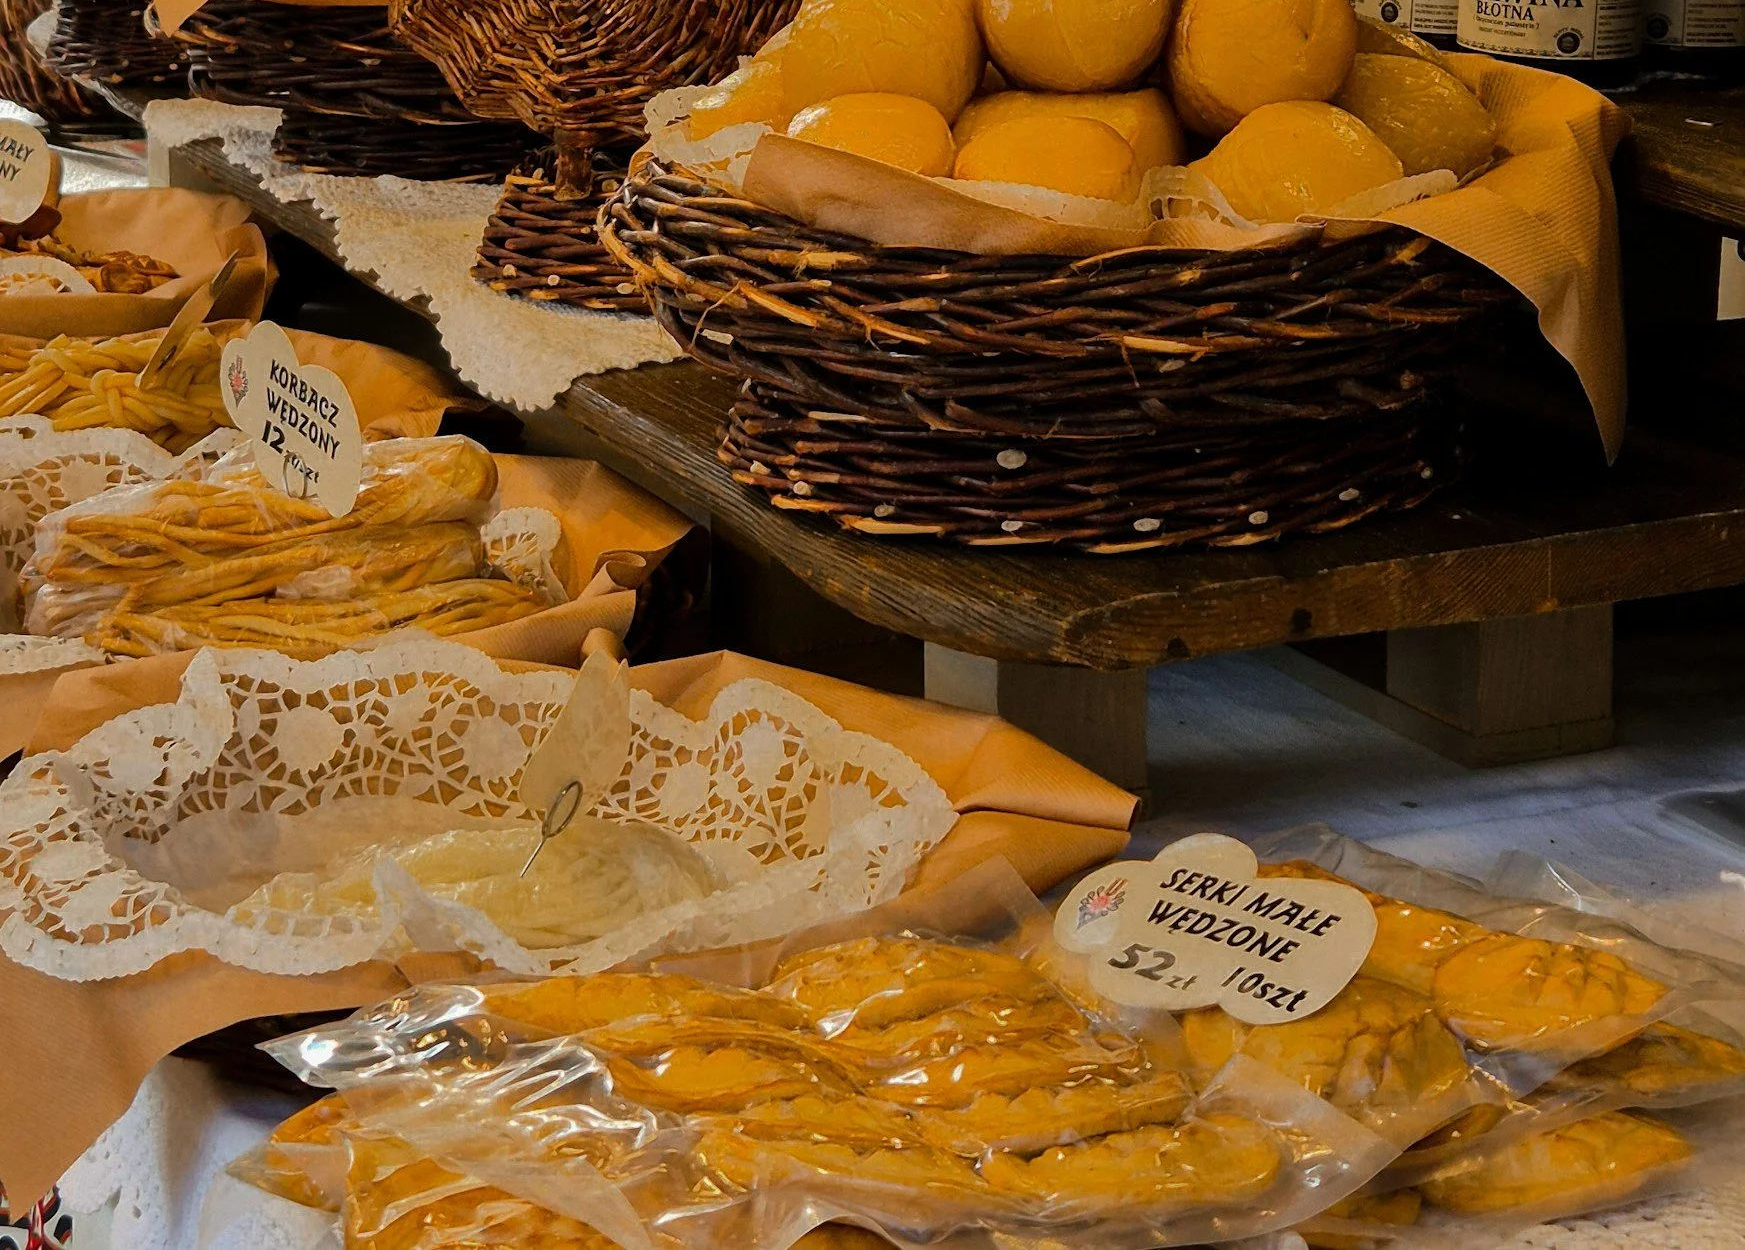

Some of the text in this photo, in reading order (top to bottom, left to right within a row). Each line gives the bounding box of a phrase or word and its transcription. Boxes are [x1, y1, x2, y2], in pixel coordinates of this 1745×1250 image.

[1476, 0, 1535, 21] BŁOTNA
[266, 386, 341, 460] WĘDZONY
[269, 358, 340, 428] KORBACZ
[261, 419, 286, 455] 12
[1146, 899, 1301, 963] WĘDZONE
[1159, 867, 1342, 937] SERKI MAŁE
[1107, 943, 1176, 982] 52
[1166, 974, 1198, 991] zł
